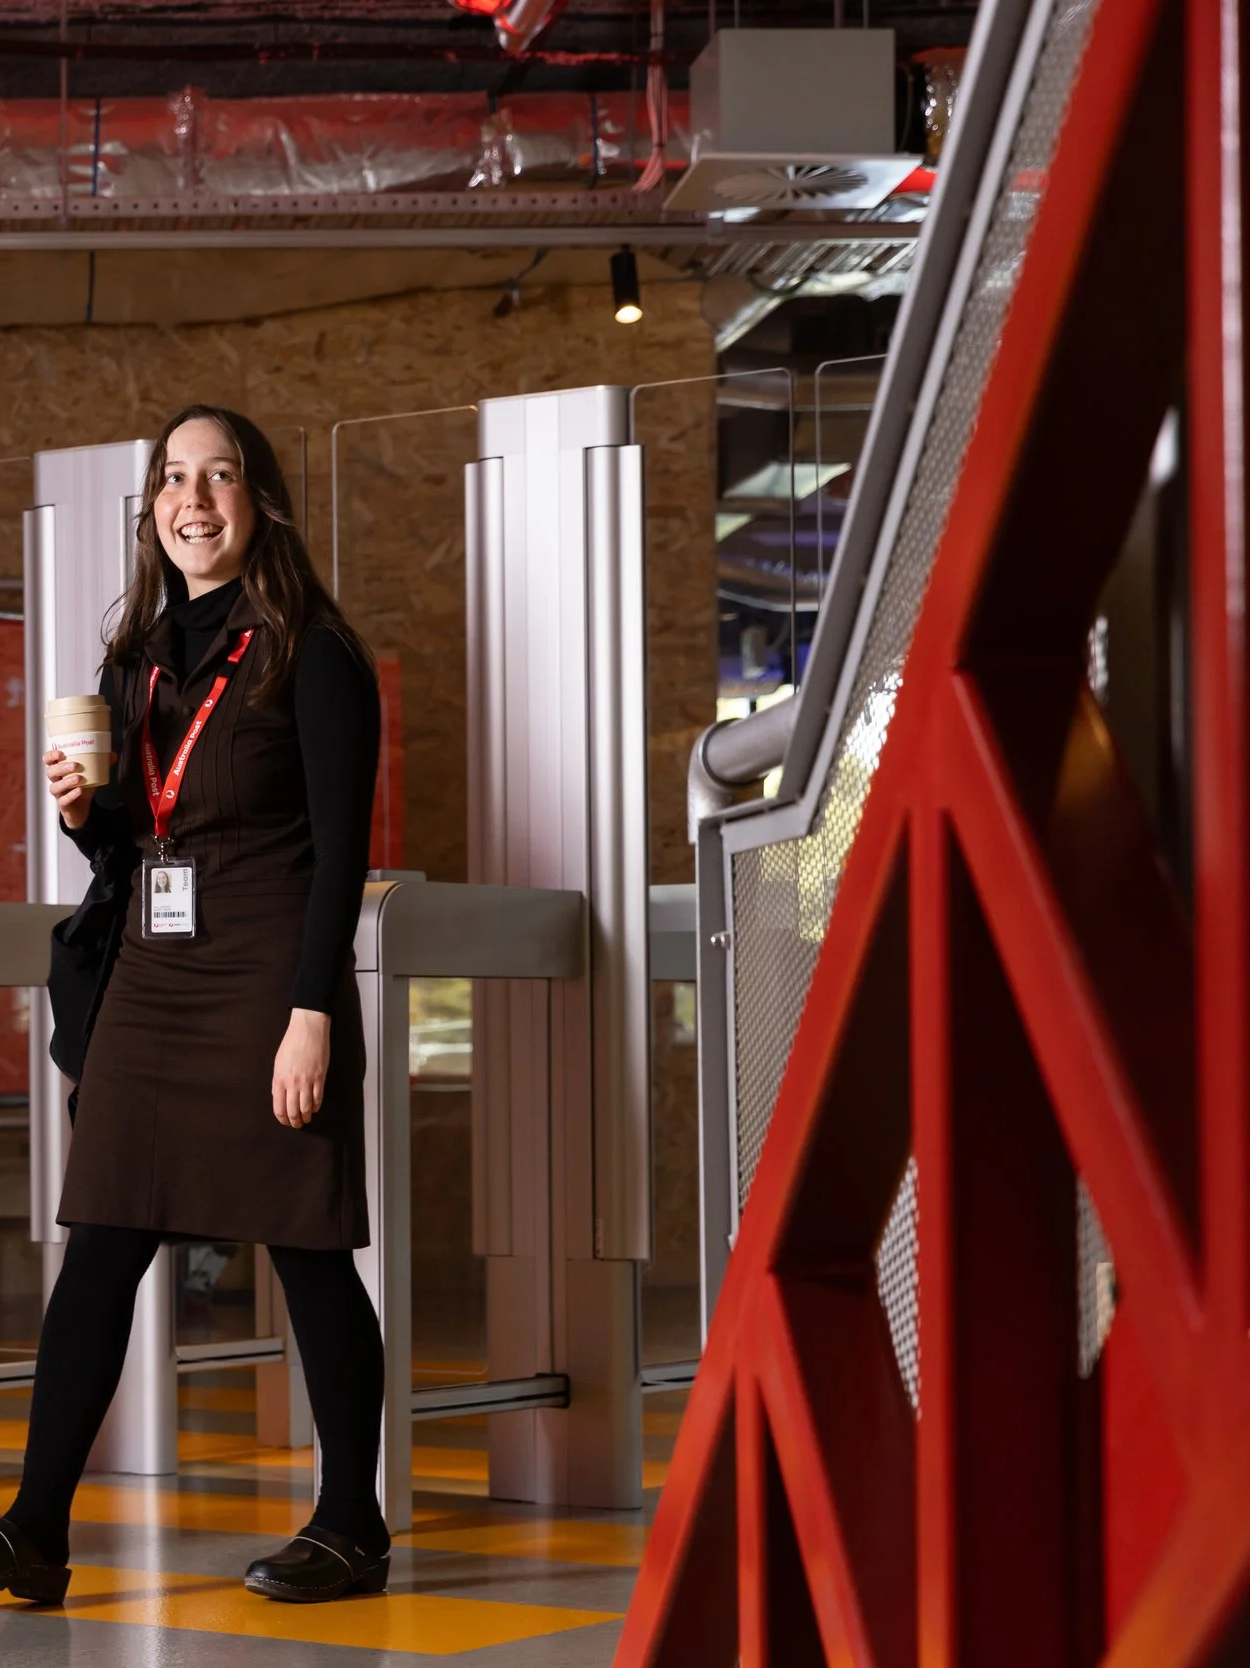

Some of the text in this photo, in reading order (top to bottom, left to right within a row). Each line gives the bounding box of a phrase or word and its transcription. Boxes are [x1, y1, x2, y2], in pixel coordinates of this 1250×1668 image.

[173, 720, 202, 776] Australia Post
[150, 777, 160, 797] Post
